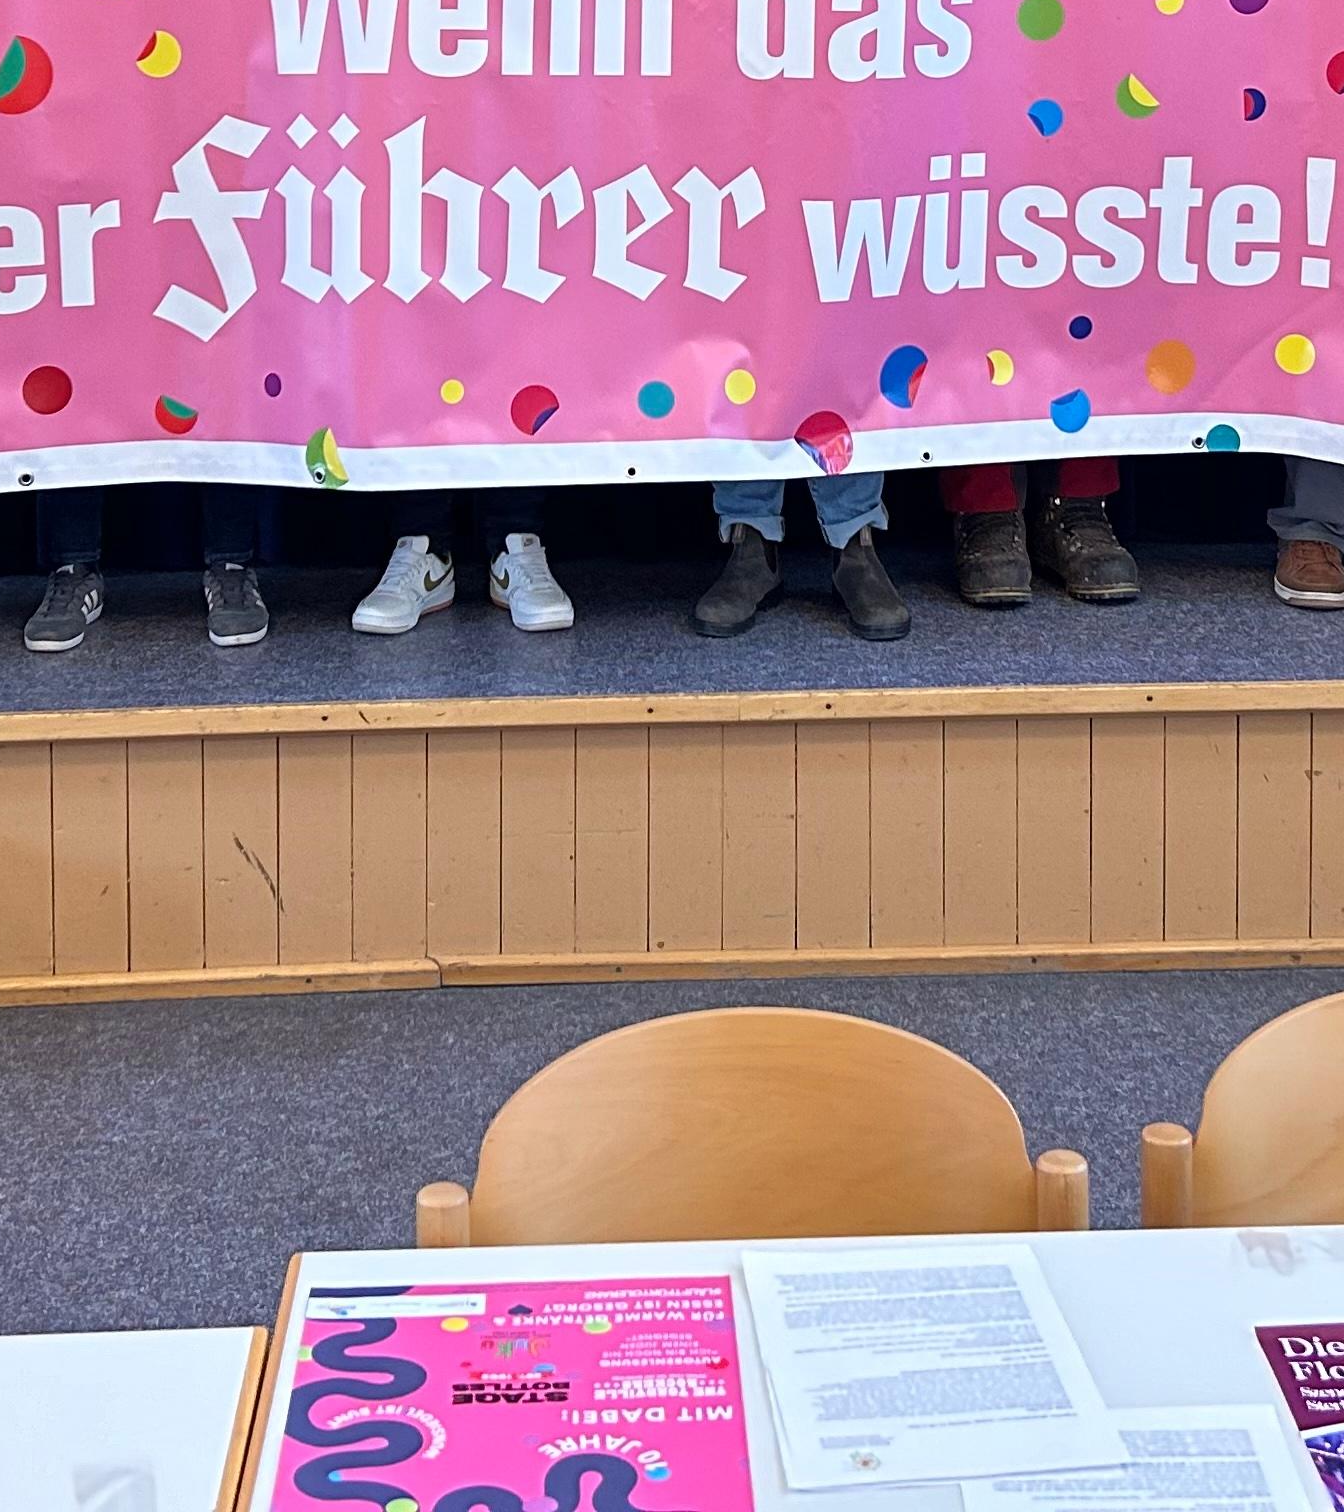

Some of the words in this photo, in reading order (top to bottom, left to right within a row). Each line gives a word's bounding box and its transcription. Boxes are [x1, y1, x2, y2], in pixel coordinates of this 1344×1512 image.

[151, 114, 767, 344] Führer
[799, 151, 1337, 305] wüsste!
[543, 1302, 628, 1313] GESORGT
[633, 1301, 661, 1310] IST
[667, 1299, 724, 1309] ESSEN
[512, 1314, 609, 1326] GETRÄNKE
[614, 1312, 685, 1323] WARME
[691, 1311, 725, 1322] FÜR
[452, 1381, 570, 1391] BOTTLES
[452, 1391, 570, 1405] STAGE
[561, 1407, 665, 1424] DABEI:
[677, 1406, 733, 1422] MIT
[537, 1434, 643, 1459] JAHRE
[636, 1450, 668, 1470] 10
